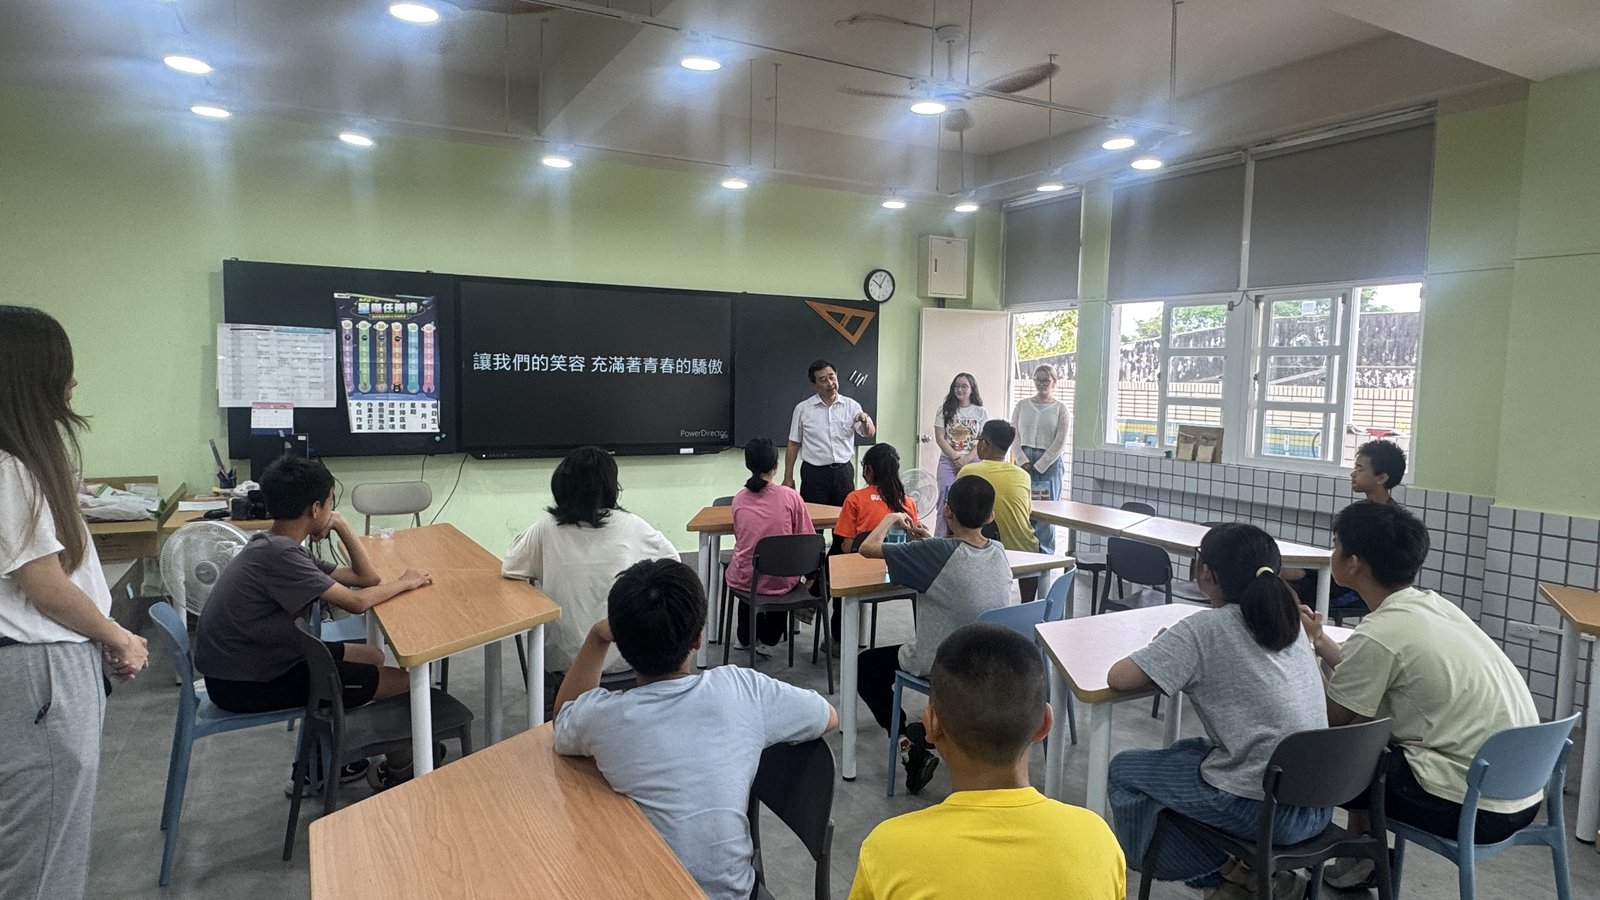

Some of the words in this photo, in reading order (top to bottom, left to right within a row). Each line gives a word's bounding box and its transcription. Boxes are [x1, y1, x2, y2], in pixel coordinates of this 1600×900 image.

[472, 352, 586, 372] 讓我們的笑容
[590, 356, 723, 375] 充滿著青春的驕傲
[410, 402, 416, 415] 星期
[680, 429, 727, 438] PowerDirector
